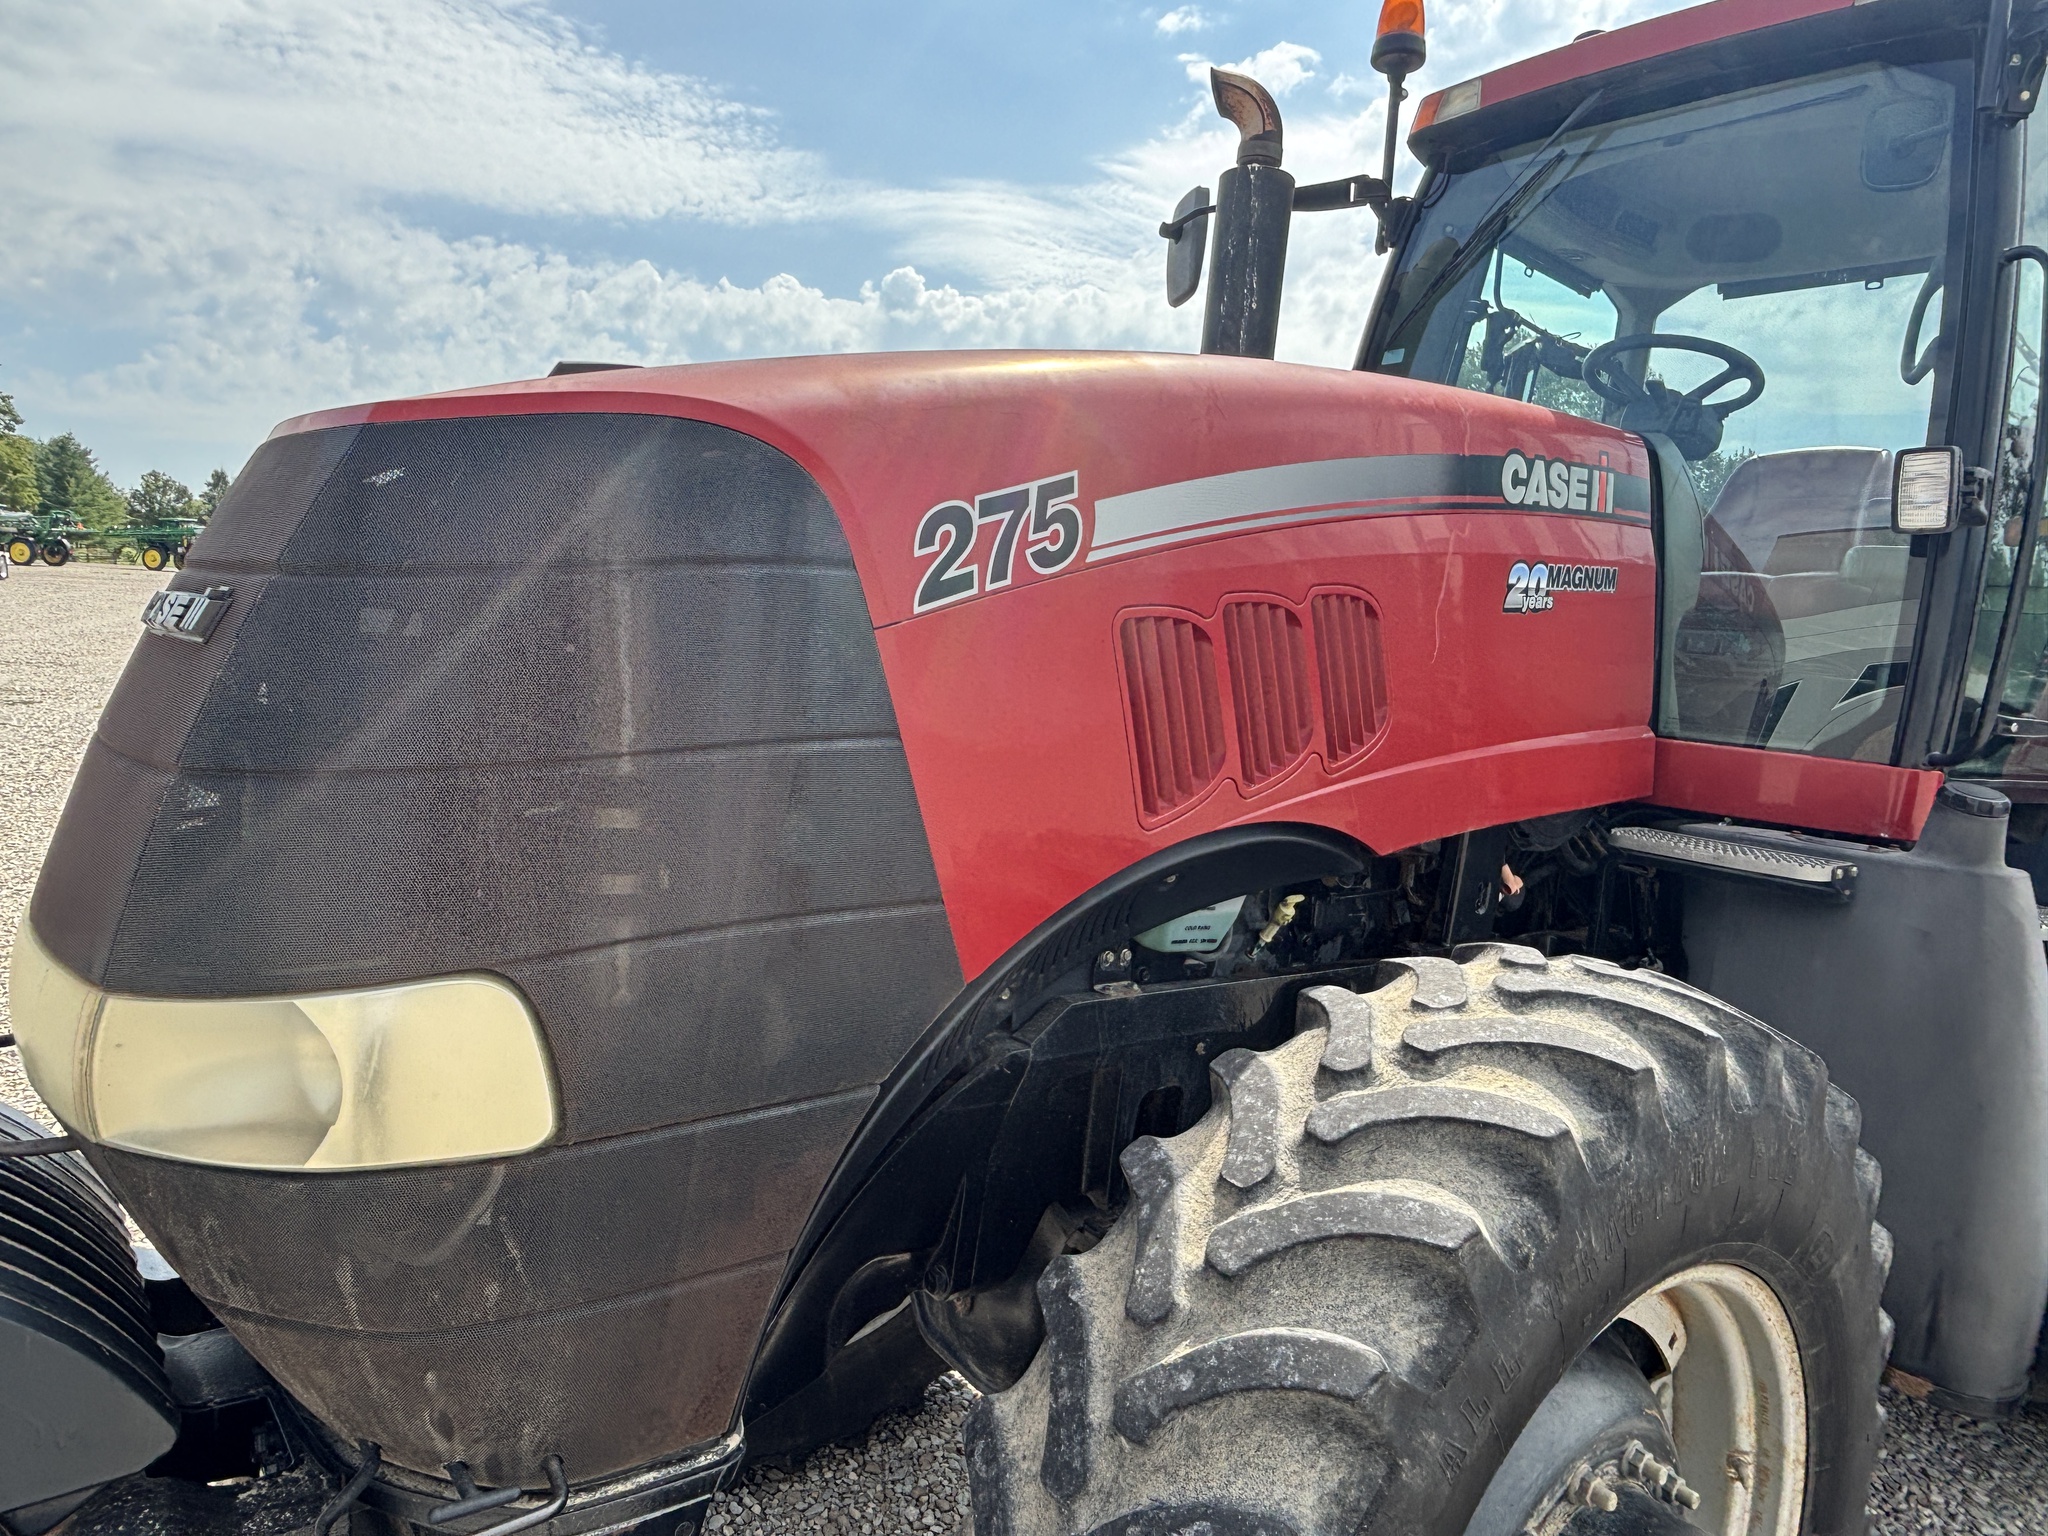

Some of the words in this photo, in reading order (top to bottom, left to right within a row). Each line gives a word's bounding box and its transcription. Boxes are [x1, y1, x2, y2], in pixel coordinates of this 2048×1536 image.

[914, 470, 1082, 615] 275
[1504, 562, 1549, 610] 20
[1546, 564, 1618, 592] MAGNUM
[1522, 594, 1553, 613] years
